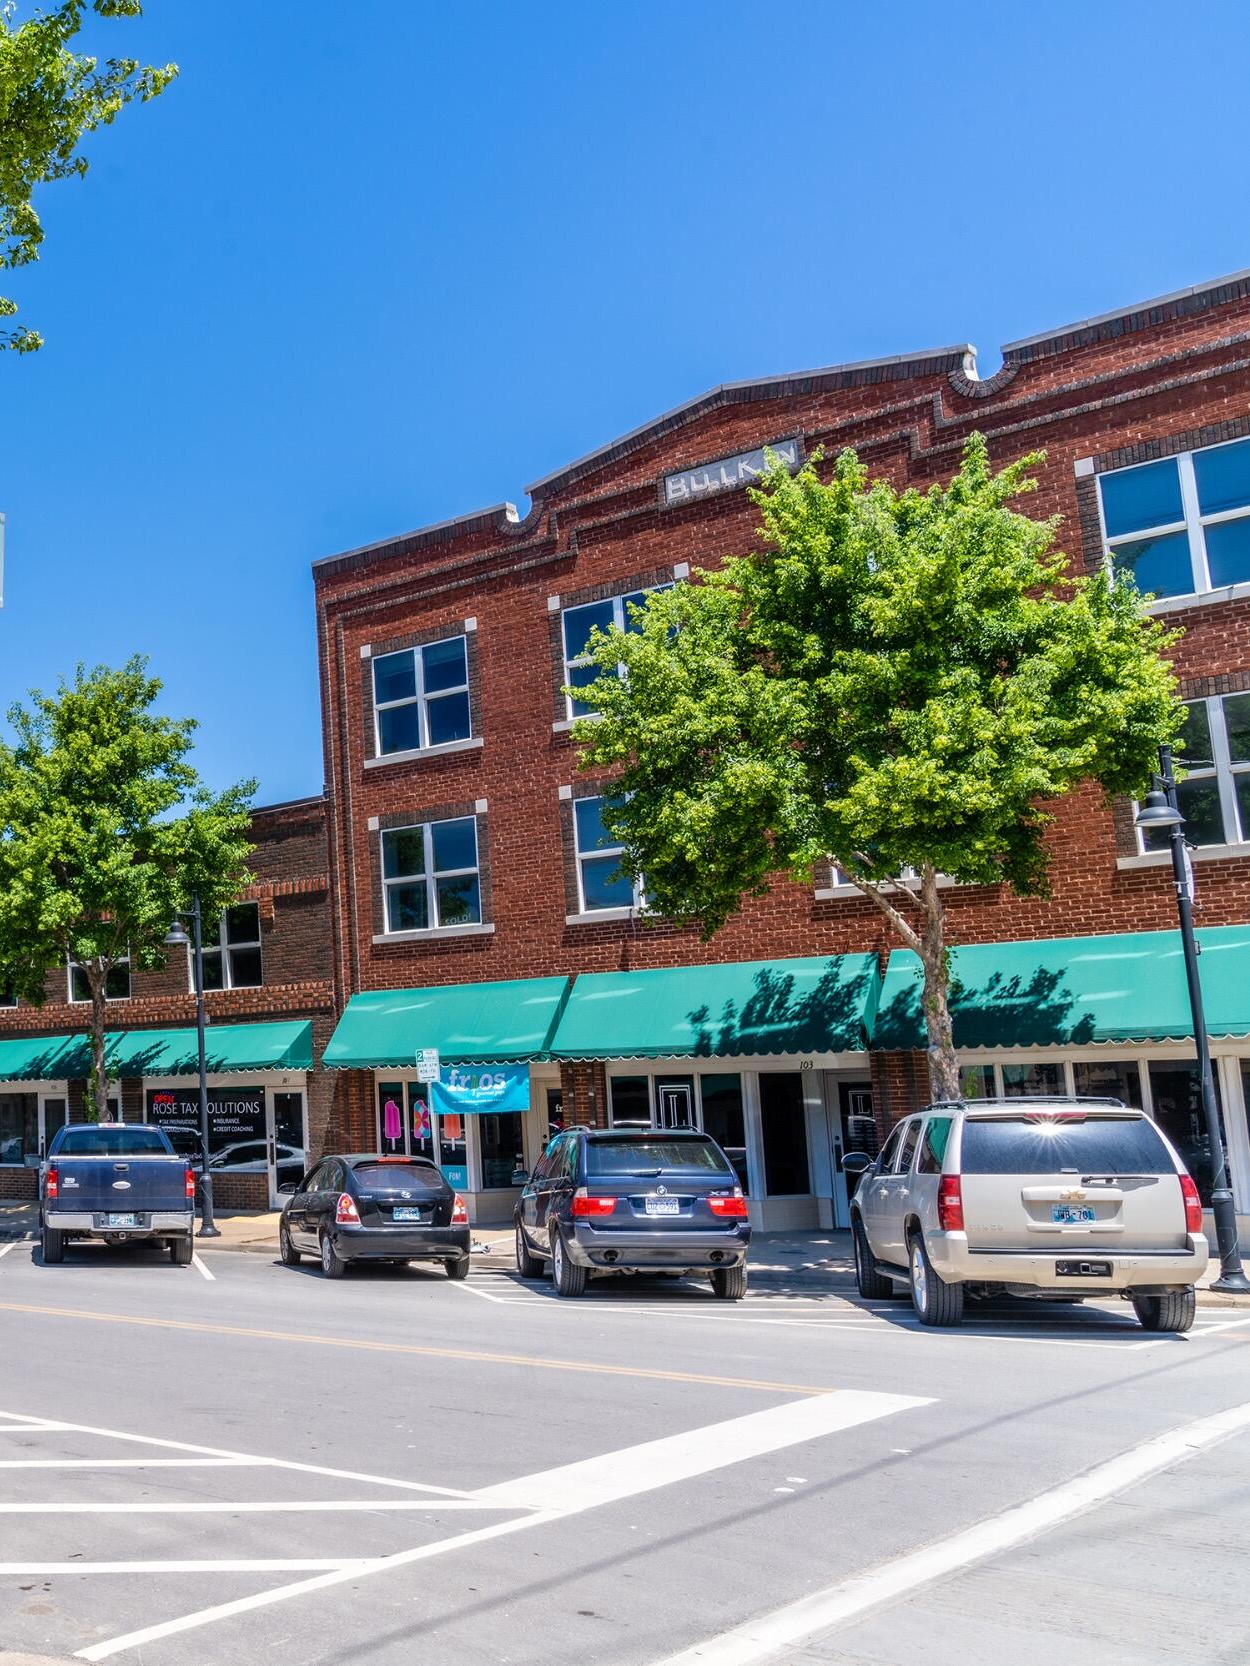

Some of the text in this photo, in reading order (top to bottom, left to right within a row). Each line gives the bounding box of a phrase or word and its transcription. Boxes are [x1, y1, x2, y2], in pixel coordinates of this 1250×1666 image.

[667, 444, 796, 501] BULKN
[417, 1052, 423, 1061] 2
[799, 1061, 814, 1070] 103
[152, 1101, 260, 1114] ROSE TAX OLUTIONS
